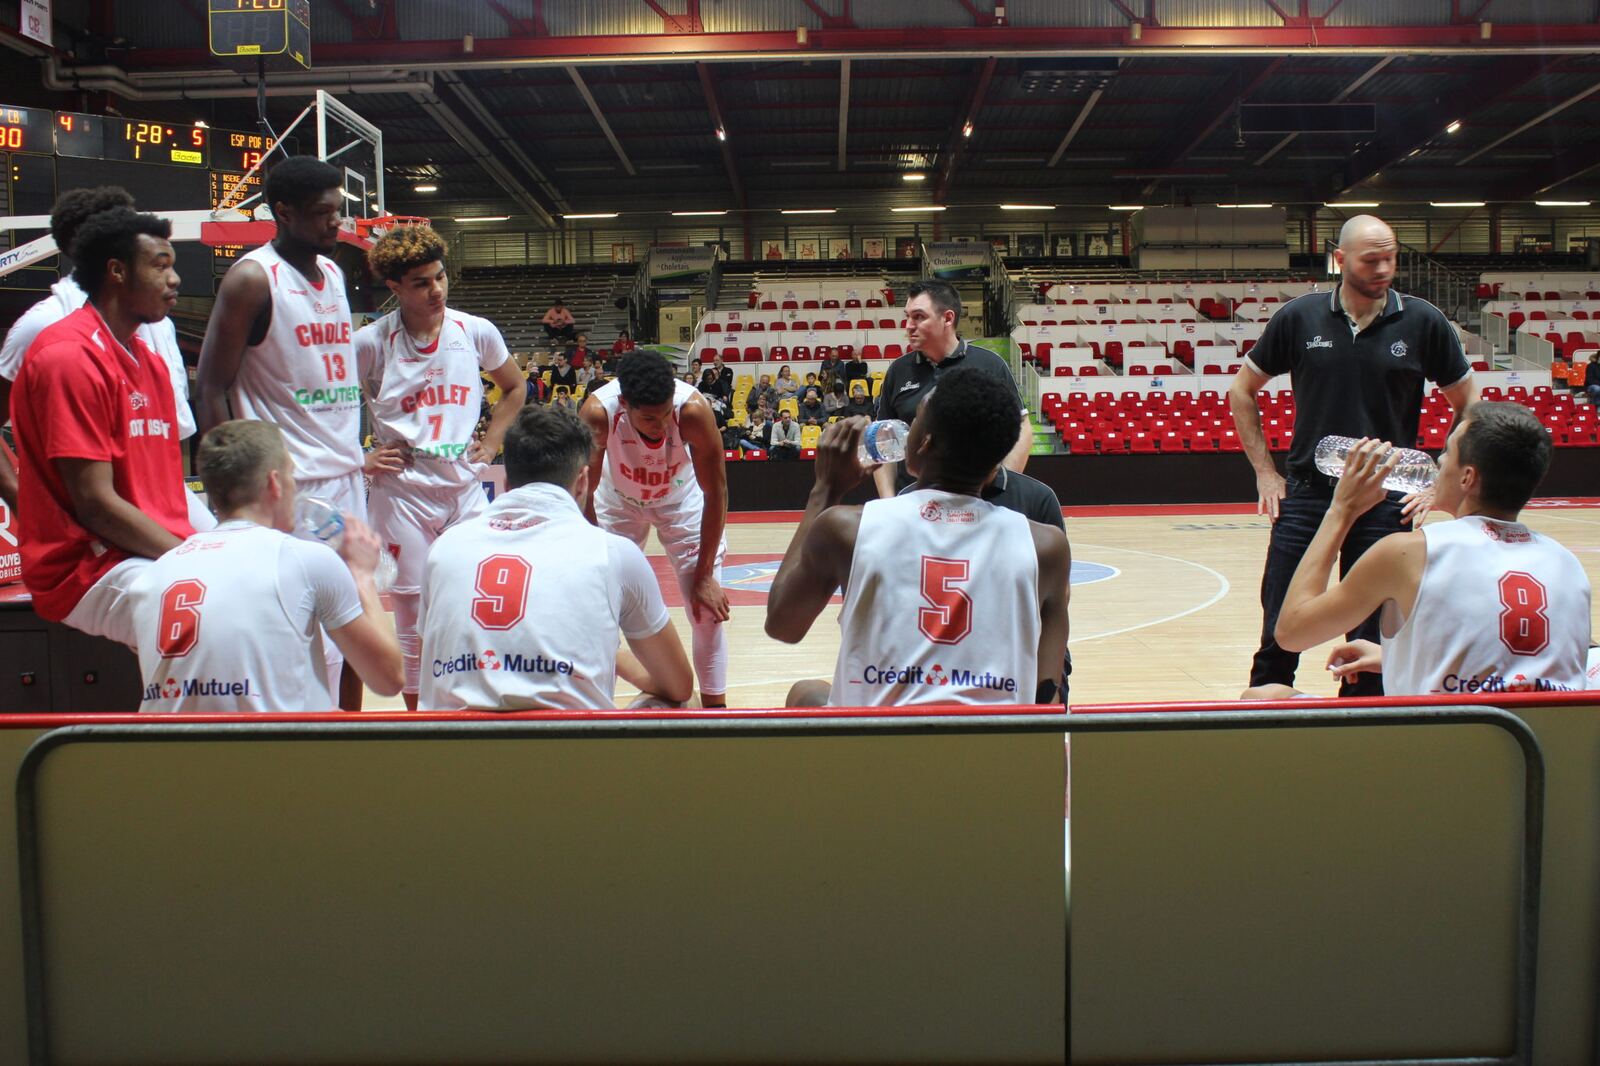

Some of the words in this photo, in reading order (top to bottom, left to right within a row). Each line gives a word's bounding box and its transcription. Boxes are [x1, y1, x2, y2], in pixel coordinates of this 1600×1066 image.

[60, 116, 72, 131] 4
[193, 129, 203, 145] 5
[230, 133, 245, 148] ESP
[135, 145, 140, 159] 1
[322, 353, 346, 383] 13
[428, 414, 443, 441] 7
[619, 461, 681, 487] CHOLT
[471, 553, 534, 632] 9
[918, 555, 974, 646] 5
[156, 578, 208, 659] 6
[1497, 570, 1550, 657] 8
[433, 654, 478, 678] Crédit
[504, 654, 574, 676] Mutuel
[863, 664, 924, 685] Crédit
[182, 678, 249, 697] Mutuel
[1442, 673, 1506, 692] Crédit
